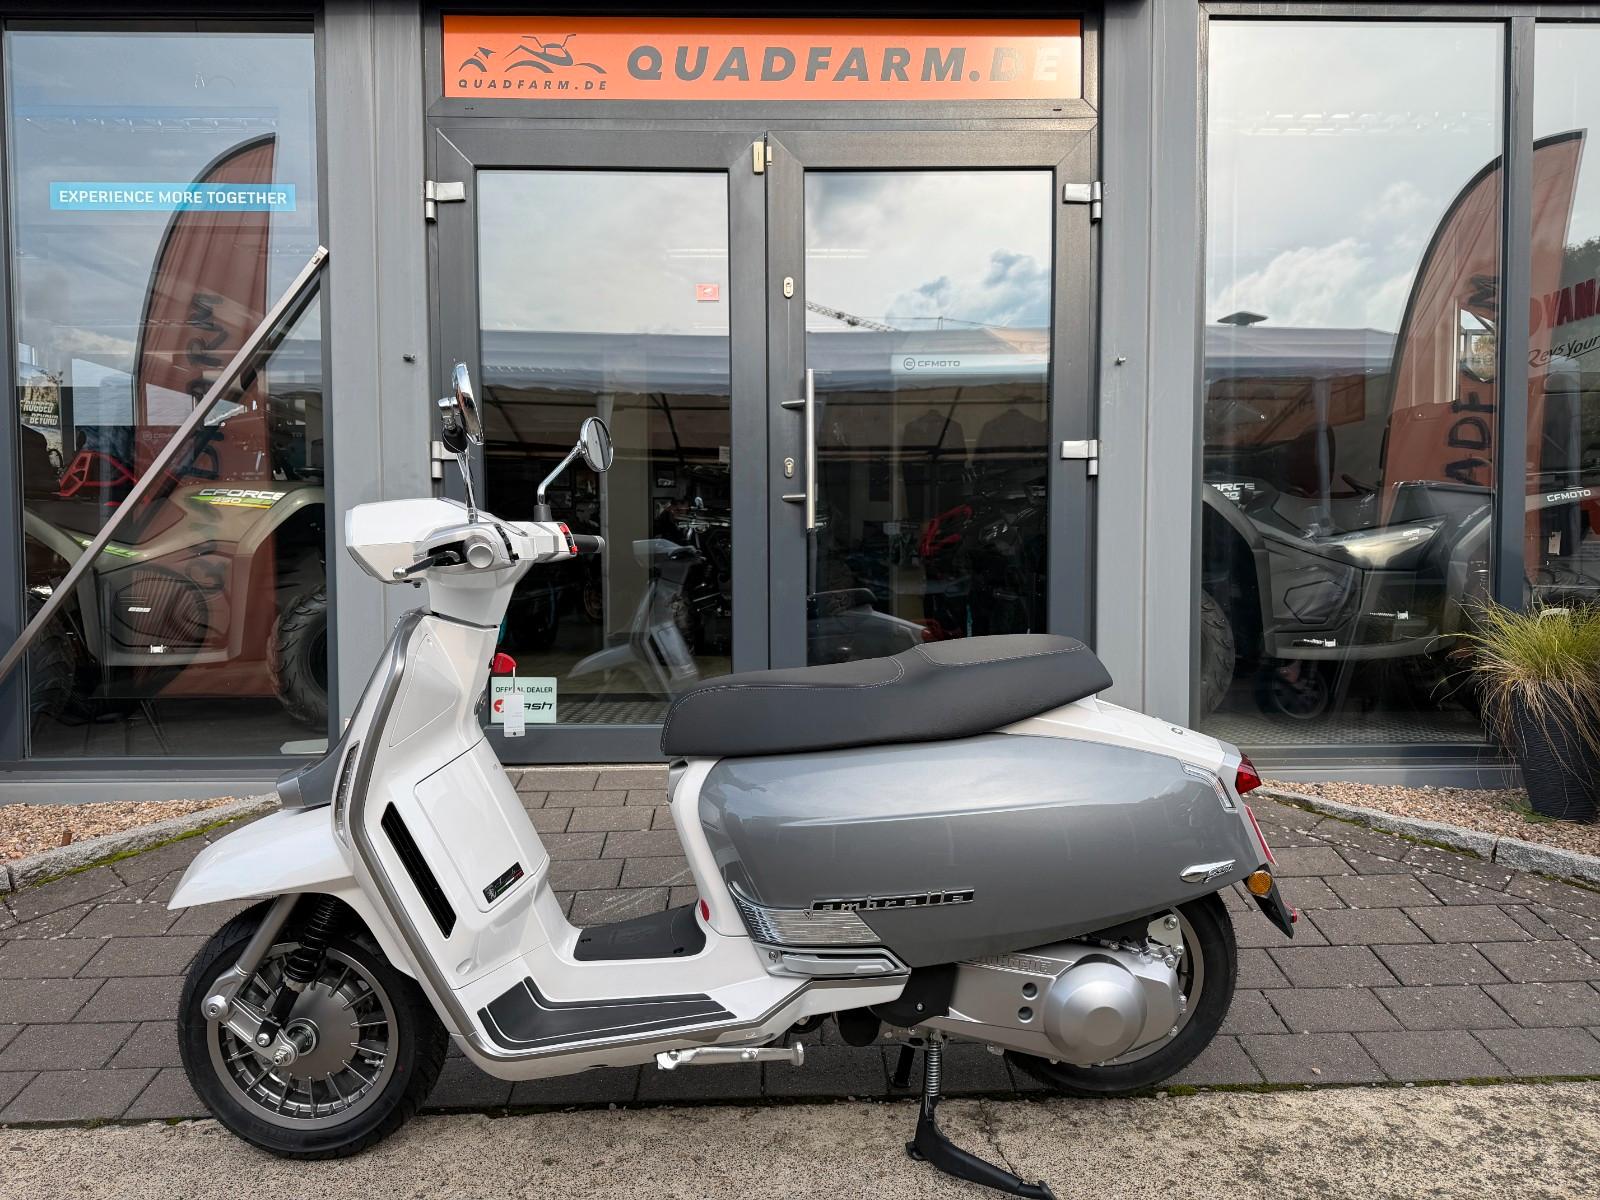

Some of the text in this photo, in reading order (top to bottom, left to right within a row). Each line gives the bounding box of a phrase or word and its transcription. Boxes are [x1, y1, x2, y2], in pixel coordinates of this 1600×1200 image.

[627, 45, 1061, 83] QUADFARM.DE
[458, 79, 607, 91] QUADFARM.DE
[59, 190, 287, 204] EXPERIENCE MORE TOGETHER
[30, 413, 59, 426] BEYOND
[199, 488, 287, 500] CFORCE
[1546, 490, 1591, 501] CFMOTO
